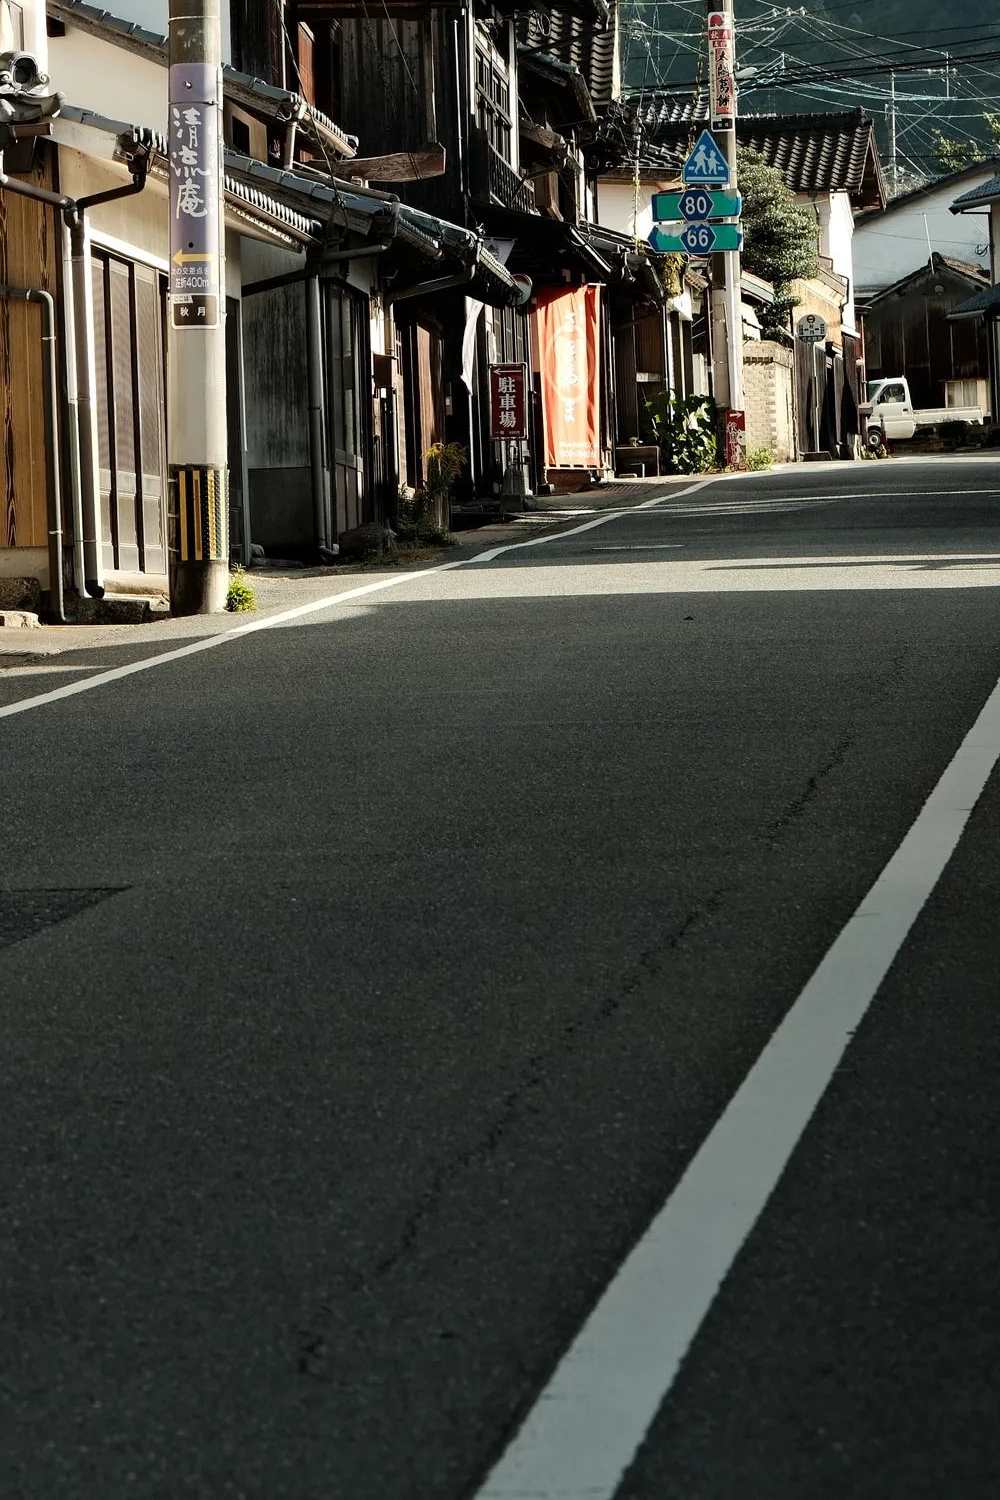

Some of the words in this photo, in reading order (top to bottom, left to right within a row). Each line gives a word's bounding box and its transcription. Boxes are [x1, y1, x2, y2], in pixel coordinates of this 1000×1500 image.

[710, 30, 729, 39] 秋月
[170, 106, 211, 220] 清流庵
[685, 196, 707, 215] 80
[687, 228, 709, 247] 66
[171, 266, 210, 276] 次の交差点を
[175, 276, 209, 288] 左折400m
[179, 306, 206, 317] 秋月
[498, 376, 517, 429] 駐車場
